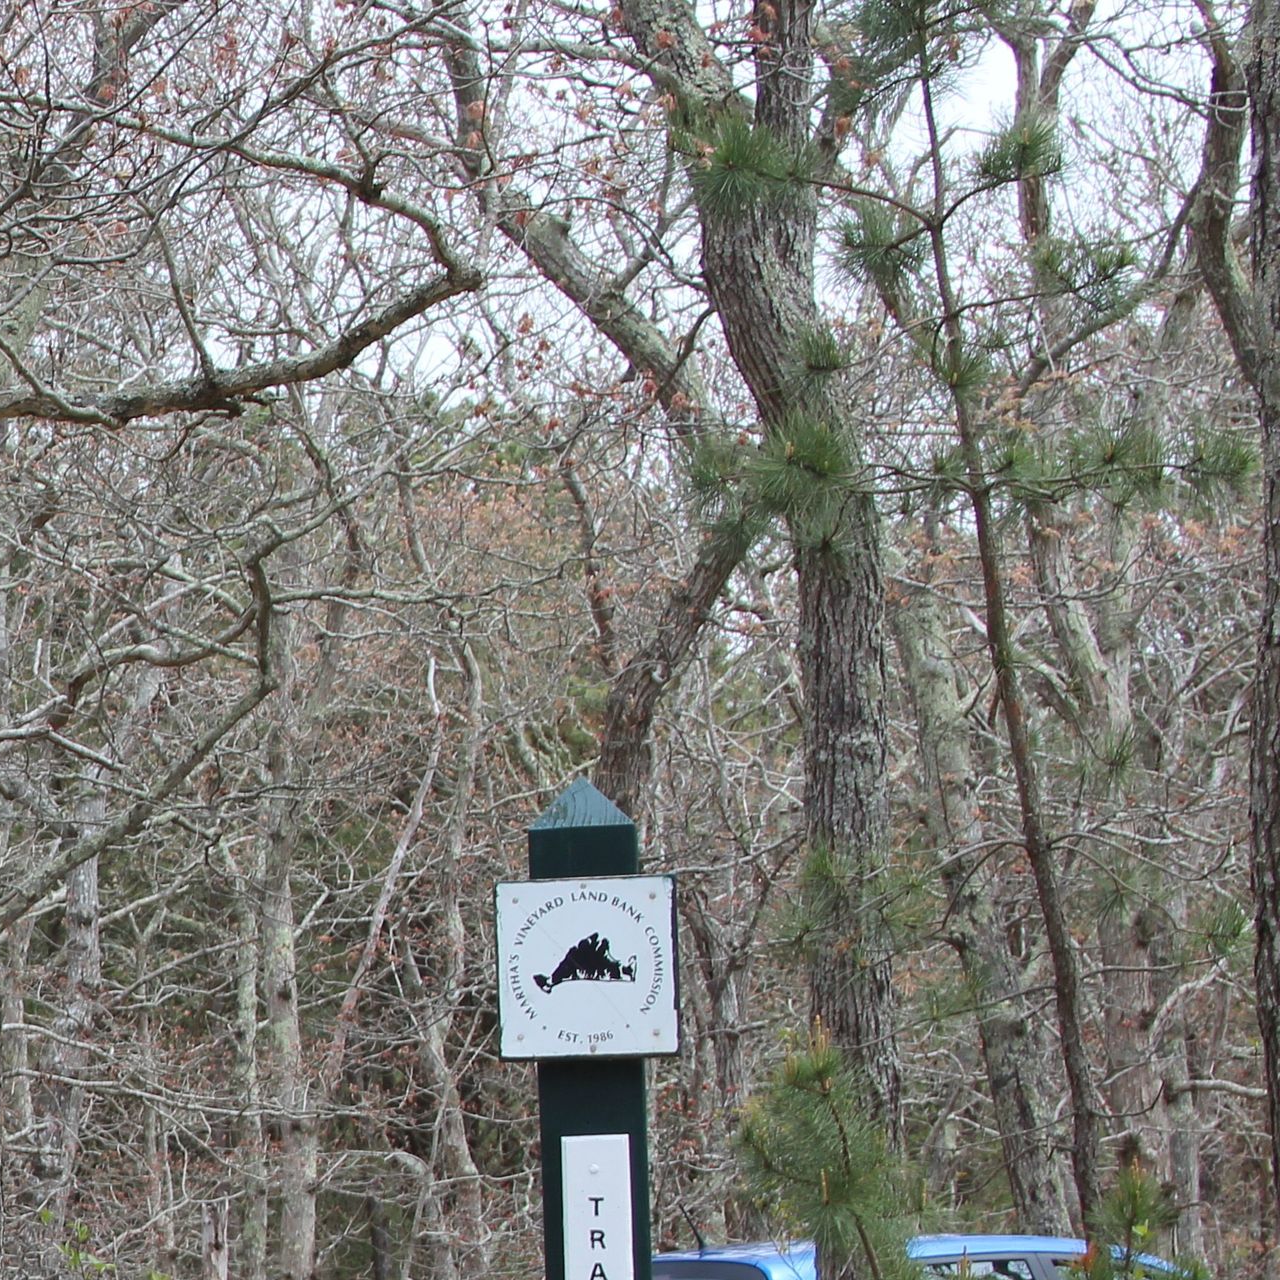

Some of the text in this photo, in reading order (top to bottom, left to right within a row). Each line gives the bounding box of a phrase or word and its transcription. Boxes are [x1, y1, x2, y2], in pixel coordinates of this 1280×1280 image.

[509, 891, 664, 1020] MARTHA'S VINEYARD LAND BANK COMMISSION
[557, 1030, 614, 1044] EST. 1986
